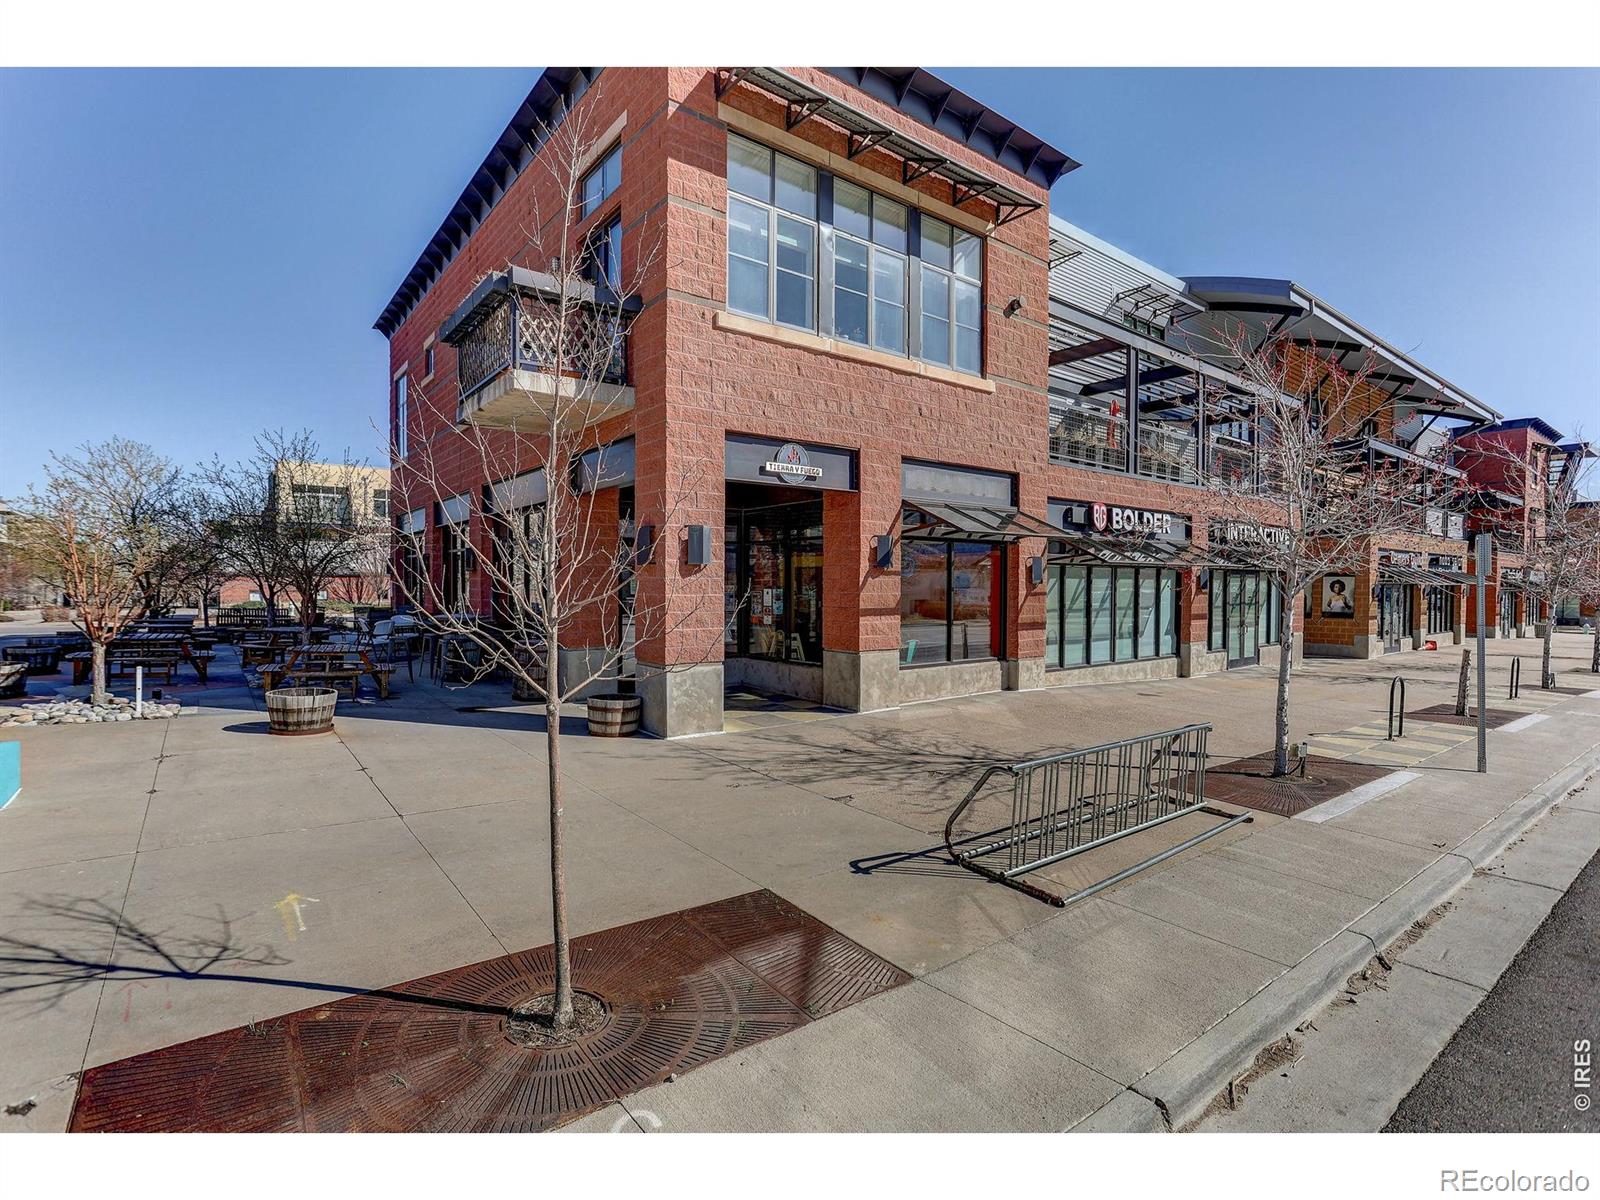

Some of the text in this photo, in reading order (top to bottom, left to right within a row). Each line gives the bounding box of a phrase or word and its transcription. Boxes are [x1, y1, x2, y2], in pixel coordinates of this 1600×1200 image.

[769, 463, 794, 473] TIERRA
[800, 467, 821, 476] FUEGO
[1112, 507, 1171, 534] BOLDER
